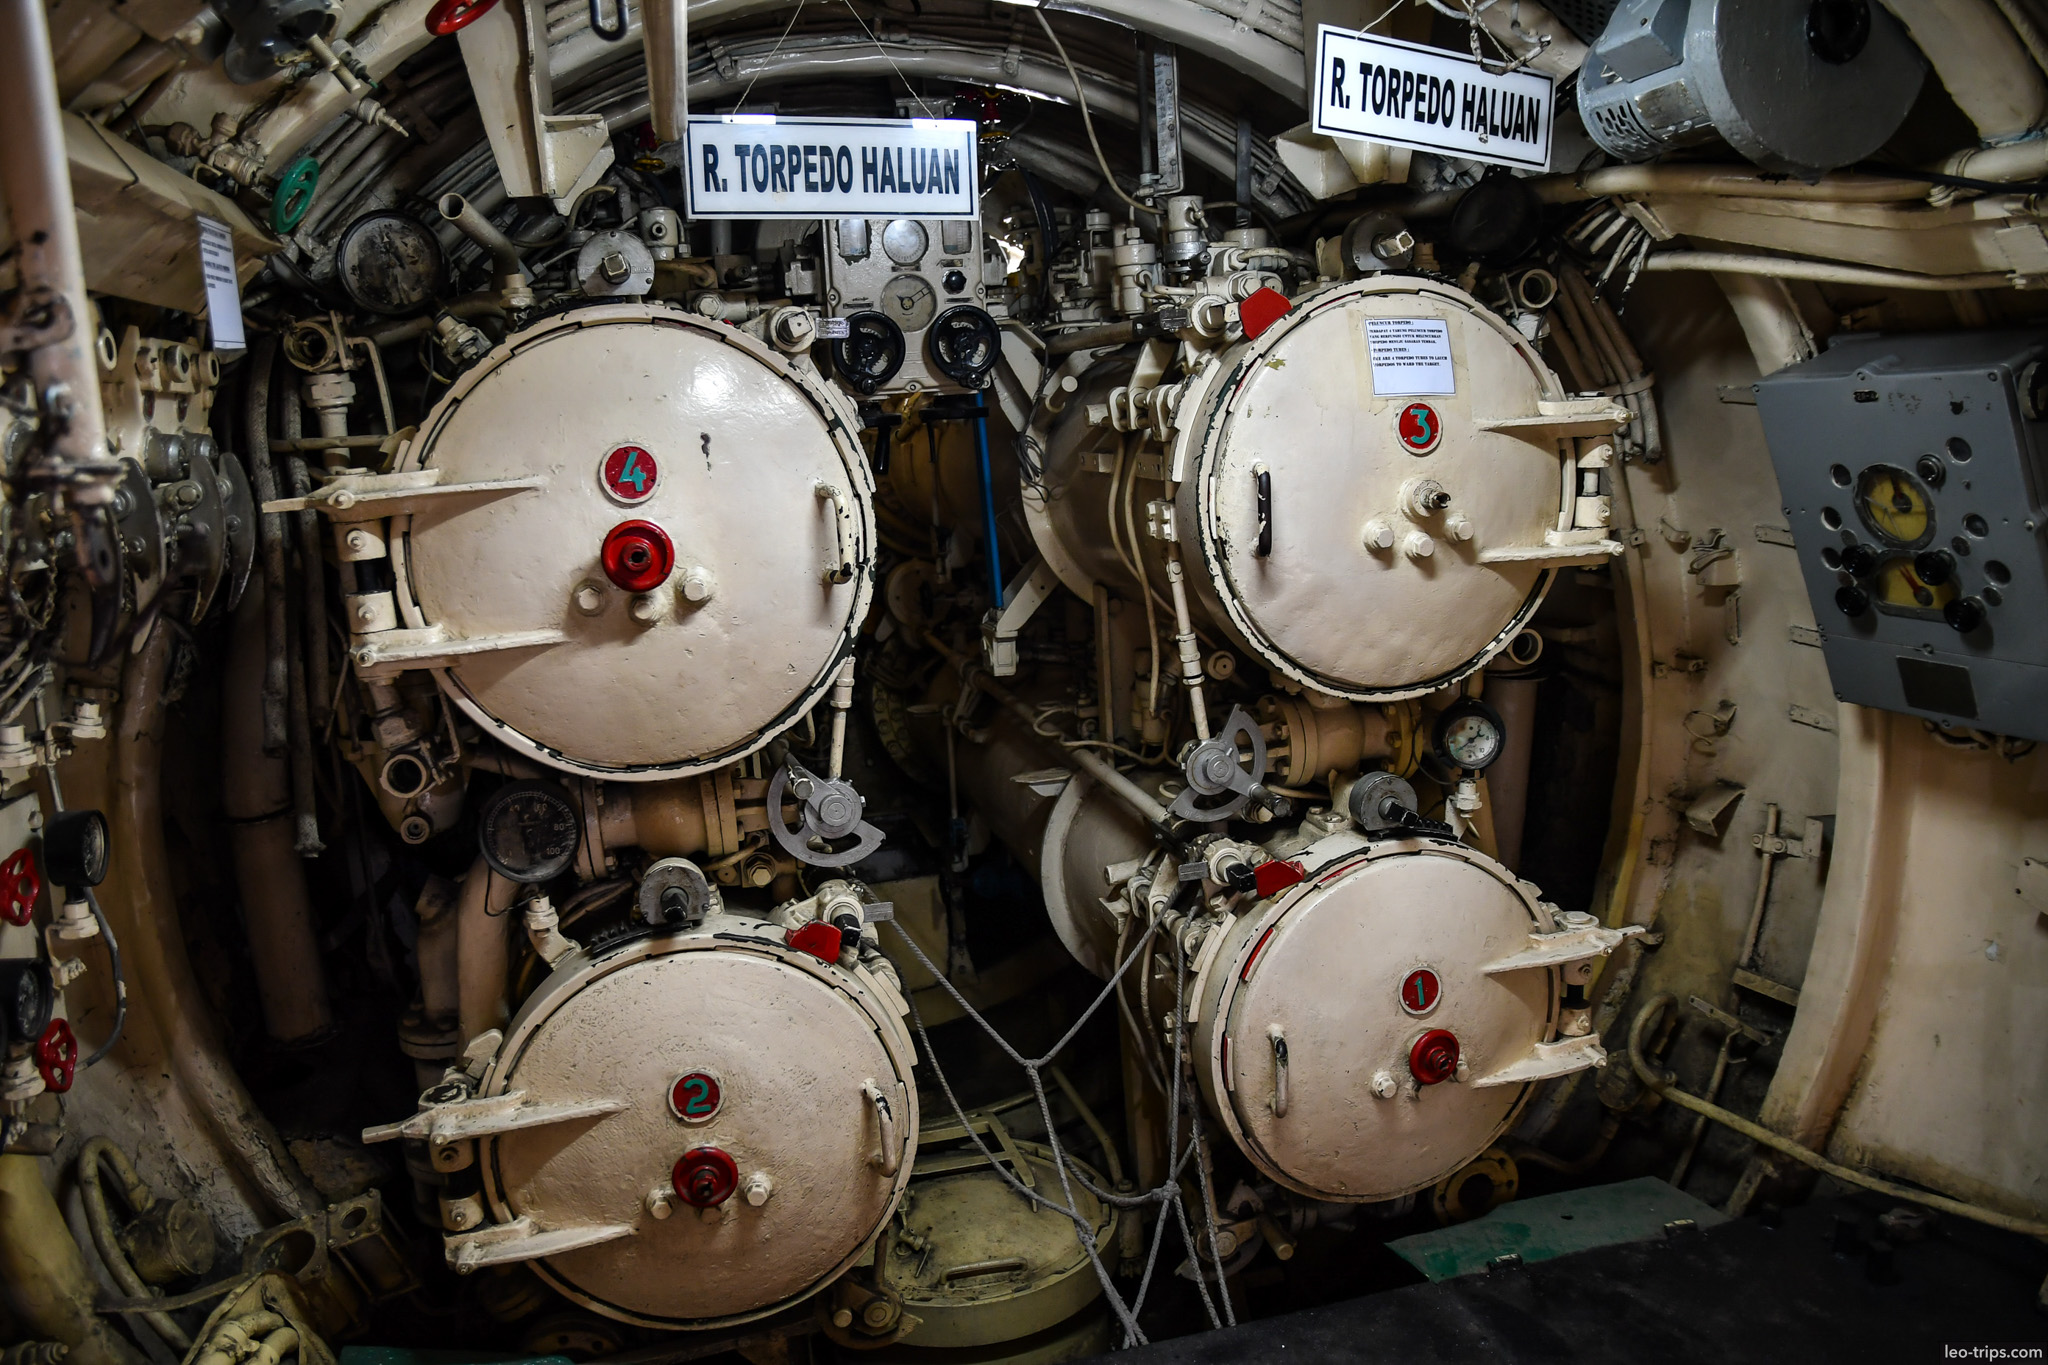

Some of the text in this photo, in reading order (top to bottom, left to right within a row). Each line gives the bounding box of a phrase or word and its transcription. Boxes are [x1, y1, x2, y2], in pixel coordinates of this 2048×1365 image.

[1331, 57, 1540, 144] R. TORPEDO HALUAN
[702, 144, 960, 195] R. TORPEDO HALUAN
[1410, 409, 1430, 444] 3
[619, 451, 647, 492] 4
[1414, 976, 1425, 1006] 1
[684, 1078, 711, 1114] 2
